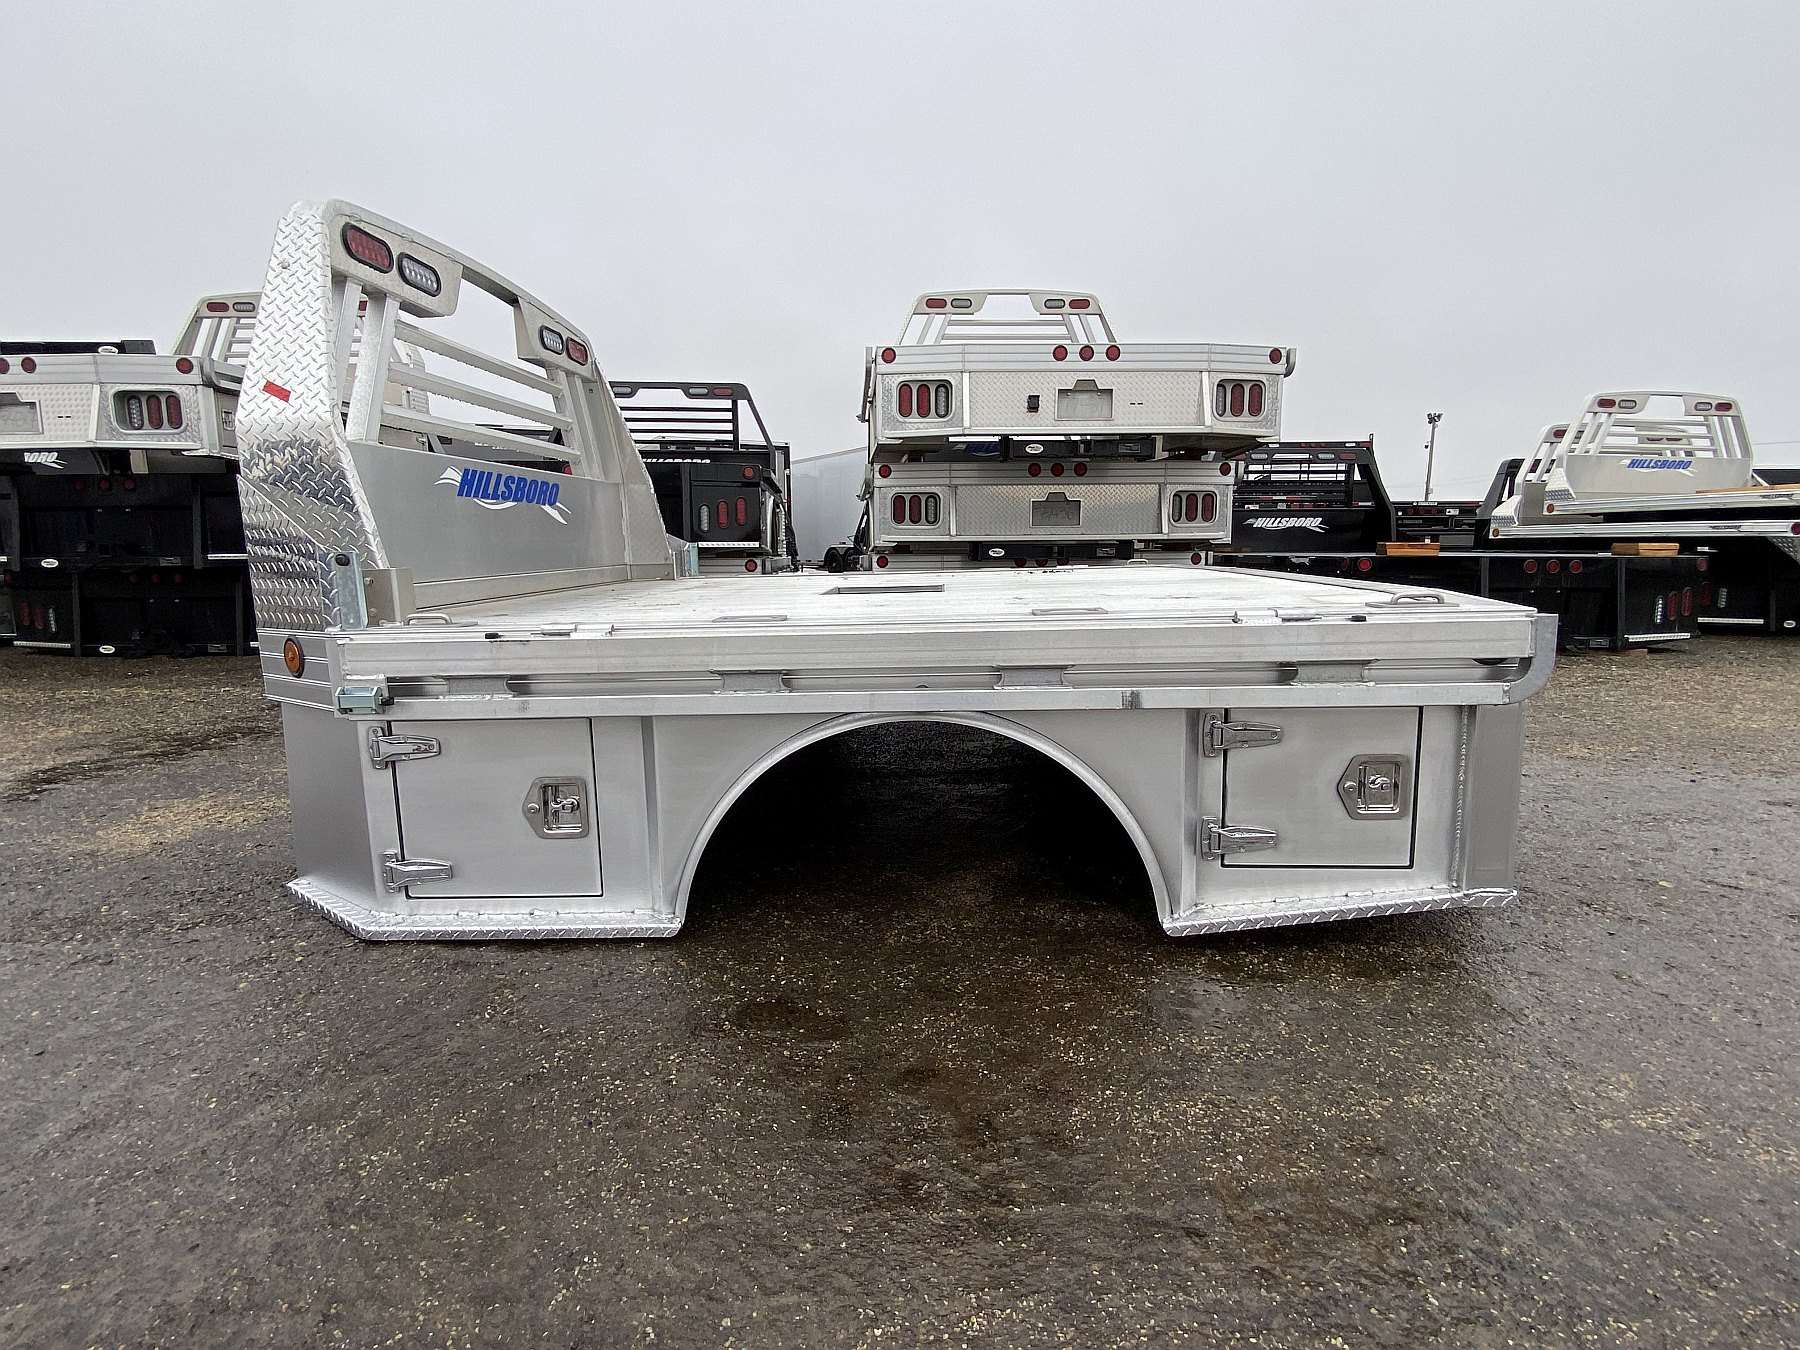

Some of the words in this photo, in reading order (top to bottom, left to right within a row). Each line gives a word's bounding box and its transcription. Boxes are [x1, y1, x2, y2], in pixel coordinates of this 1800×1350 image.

[1627, 459, 1693, 470] HILLSBORO
[457, 468, 560, 506] HILLSBORO
[1253, 517, 1323, 528] HILLSBORO
